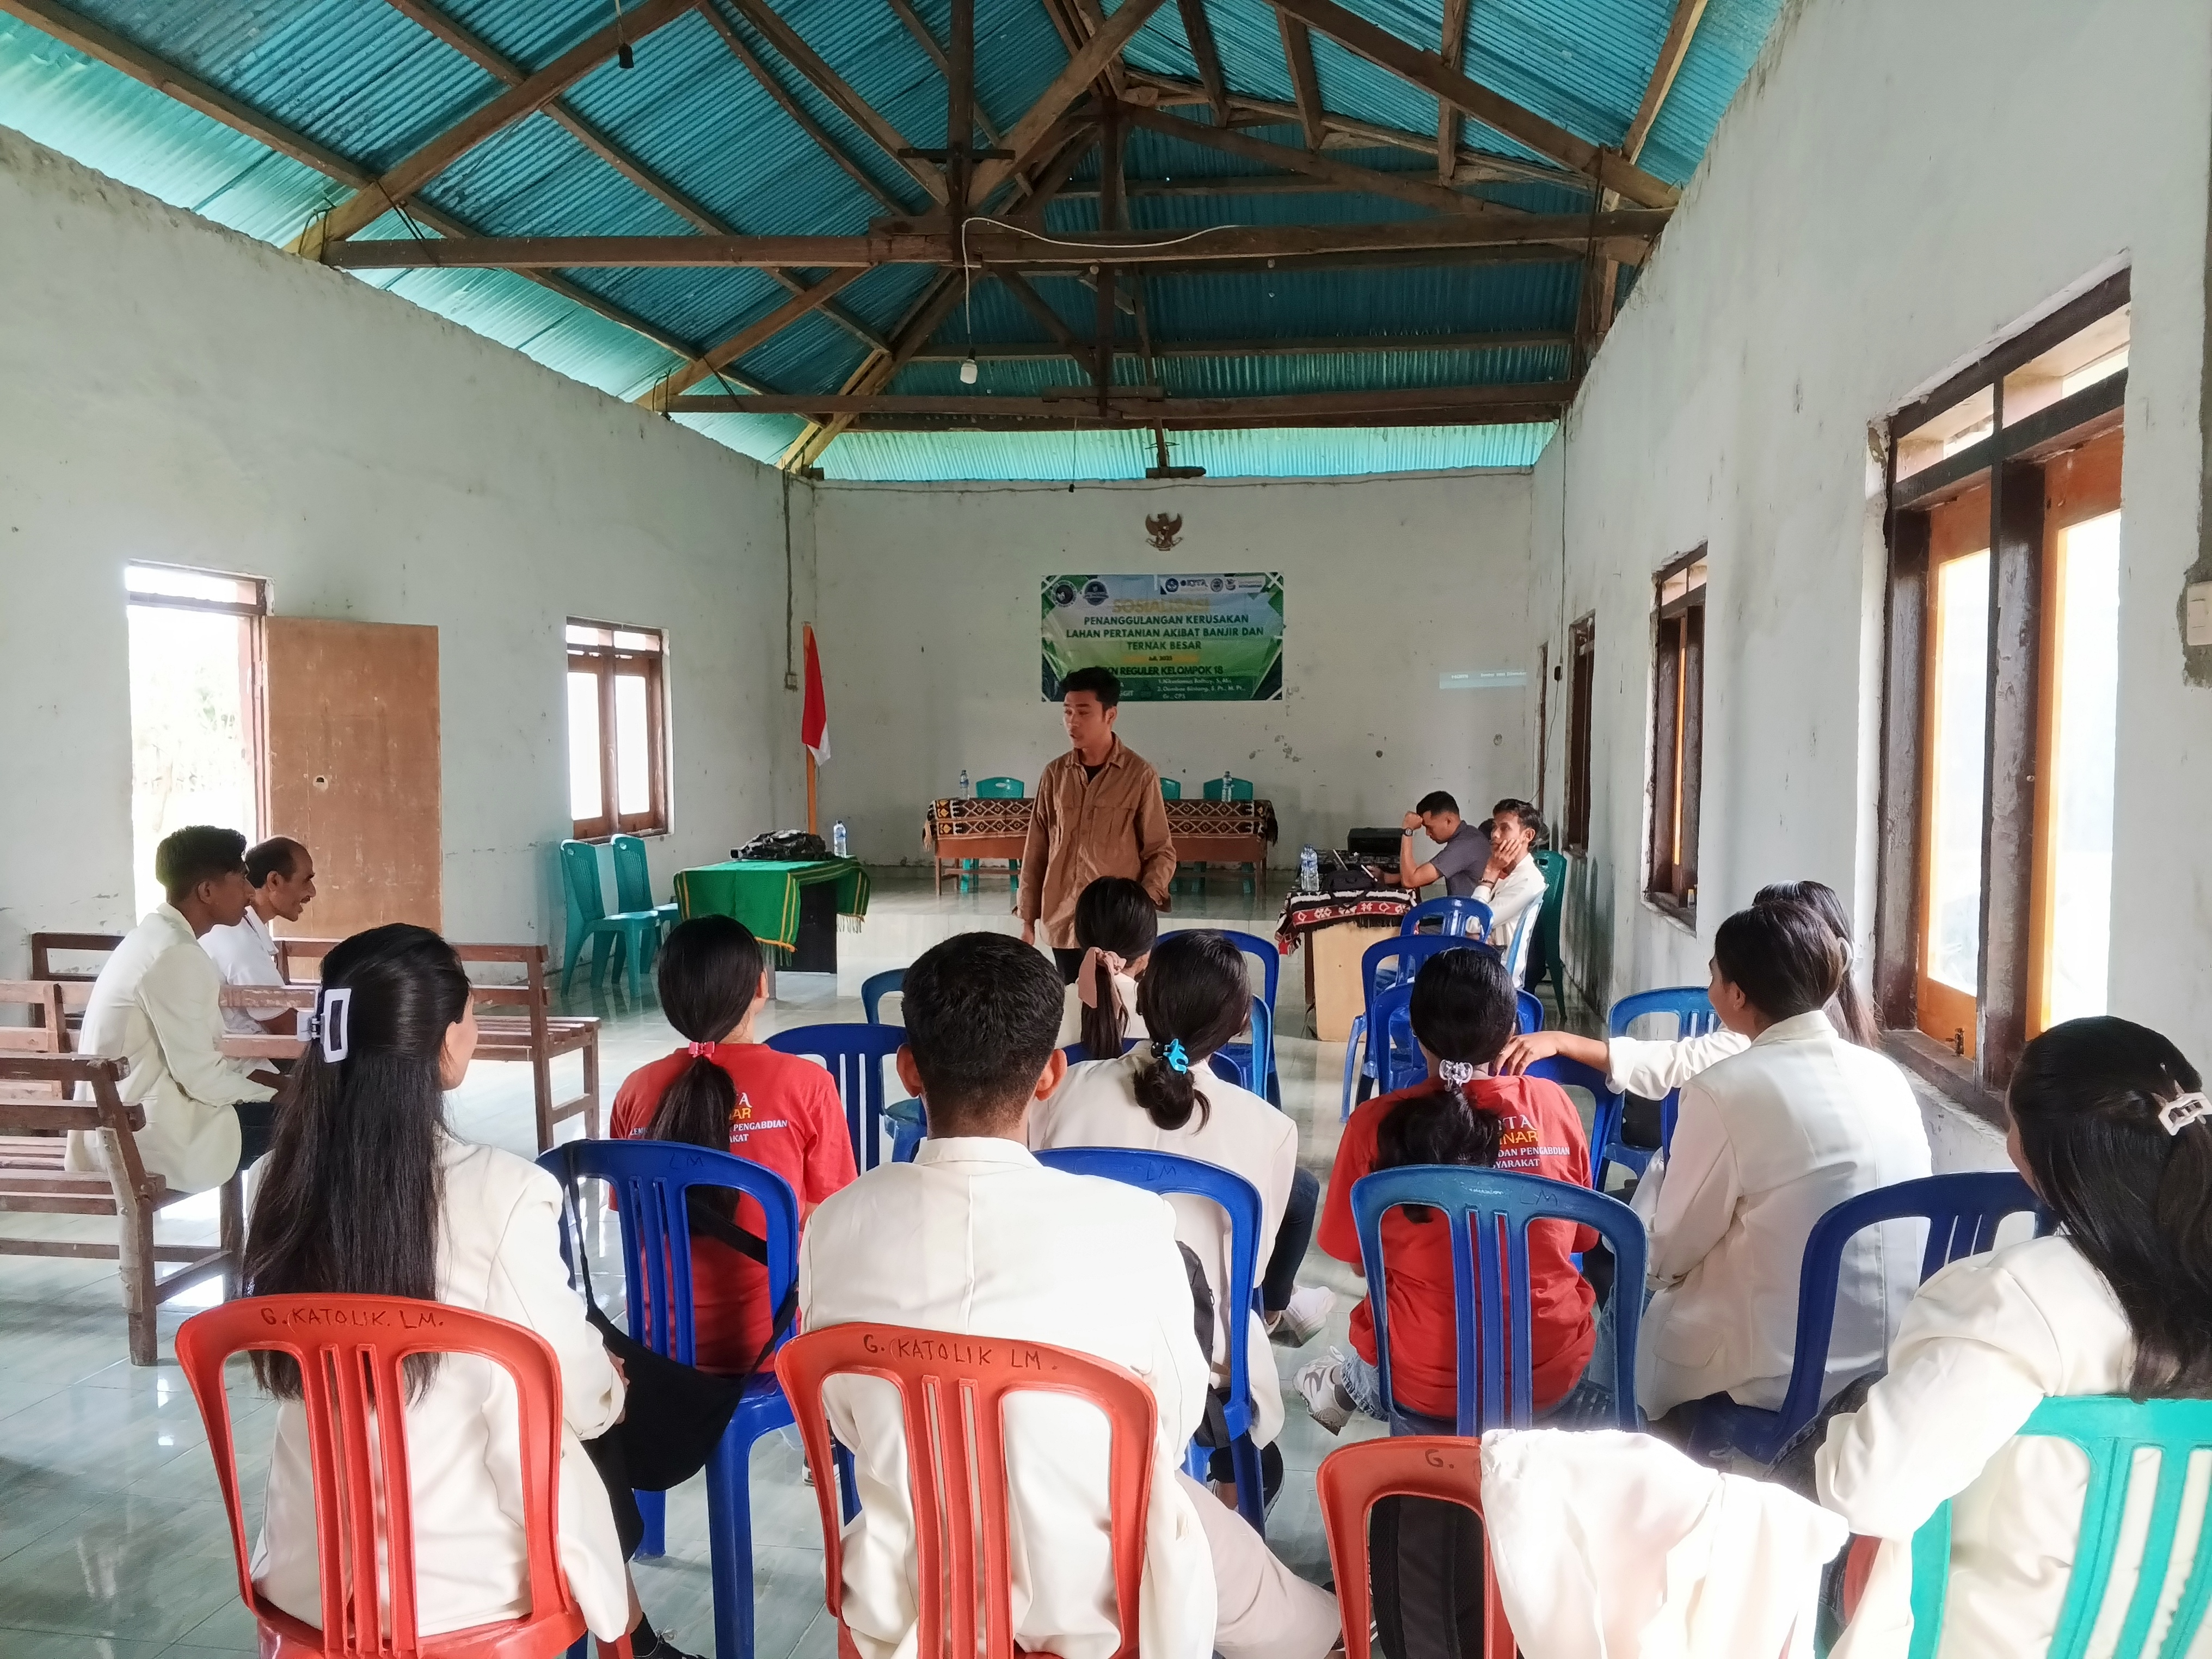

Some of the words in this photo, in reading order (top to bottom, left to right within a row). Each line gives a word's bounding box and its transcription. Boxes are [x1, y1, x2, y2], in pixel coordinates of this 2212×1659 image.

[1084, 615, 1183, 625] PENANGGULANGAN
[1185, 614, 1249, 624] KERUSAKAN
[1066, 629, 1101, 638] LAHAN
[1103, 628, 1160, 637] PERTANIAN
[1163, 628, 1200, 637] AKIBAT
[1203, 627, 1239, 636] BANJIR
[1242, 626, 1264, 636] DAN
[1127, 642, 1166, 650] TERNAK
[1170, 641, 1202, 650] BESAR
[1120, 667, 1159, 675] REGULER
[1160, 666, 1212, 675] KELOMPOK
[1214, 666, 1224, 674] 18
[733, 1120, 787, 1132] PENGABDIAN
[1498, 1148, 1518, 1158] DAN
[1520, 1146, 1570, 1156] PENGABDIAN
[863, 1334, 884, 1354] G.
[898, 1339, 992, 1365] KATOLIK
[1424, 1448, 1454, 1469] G.
